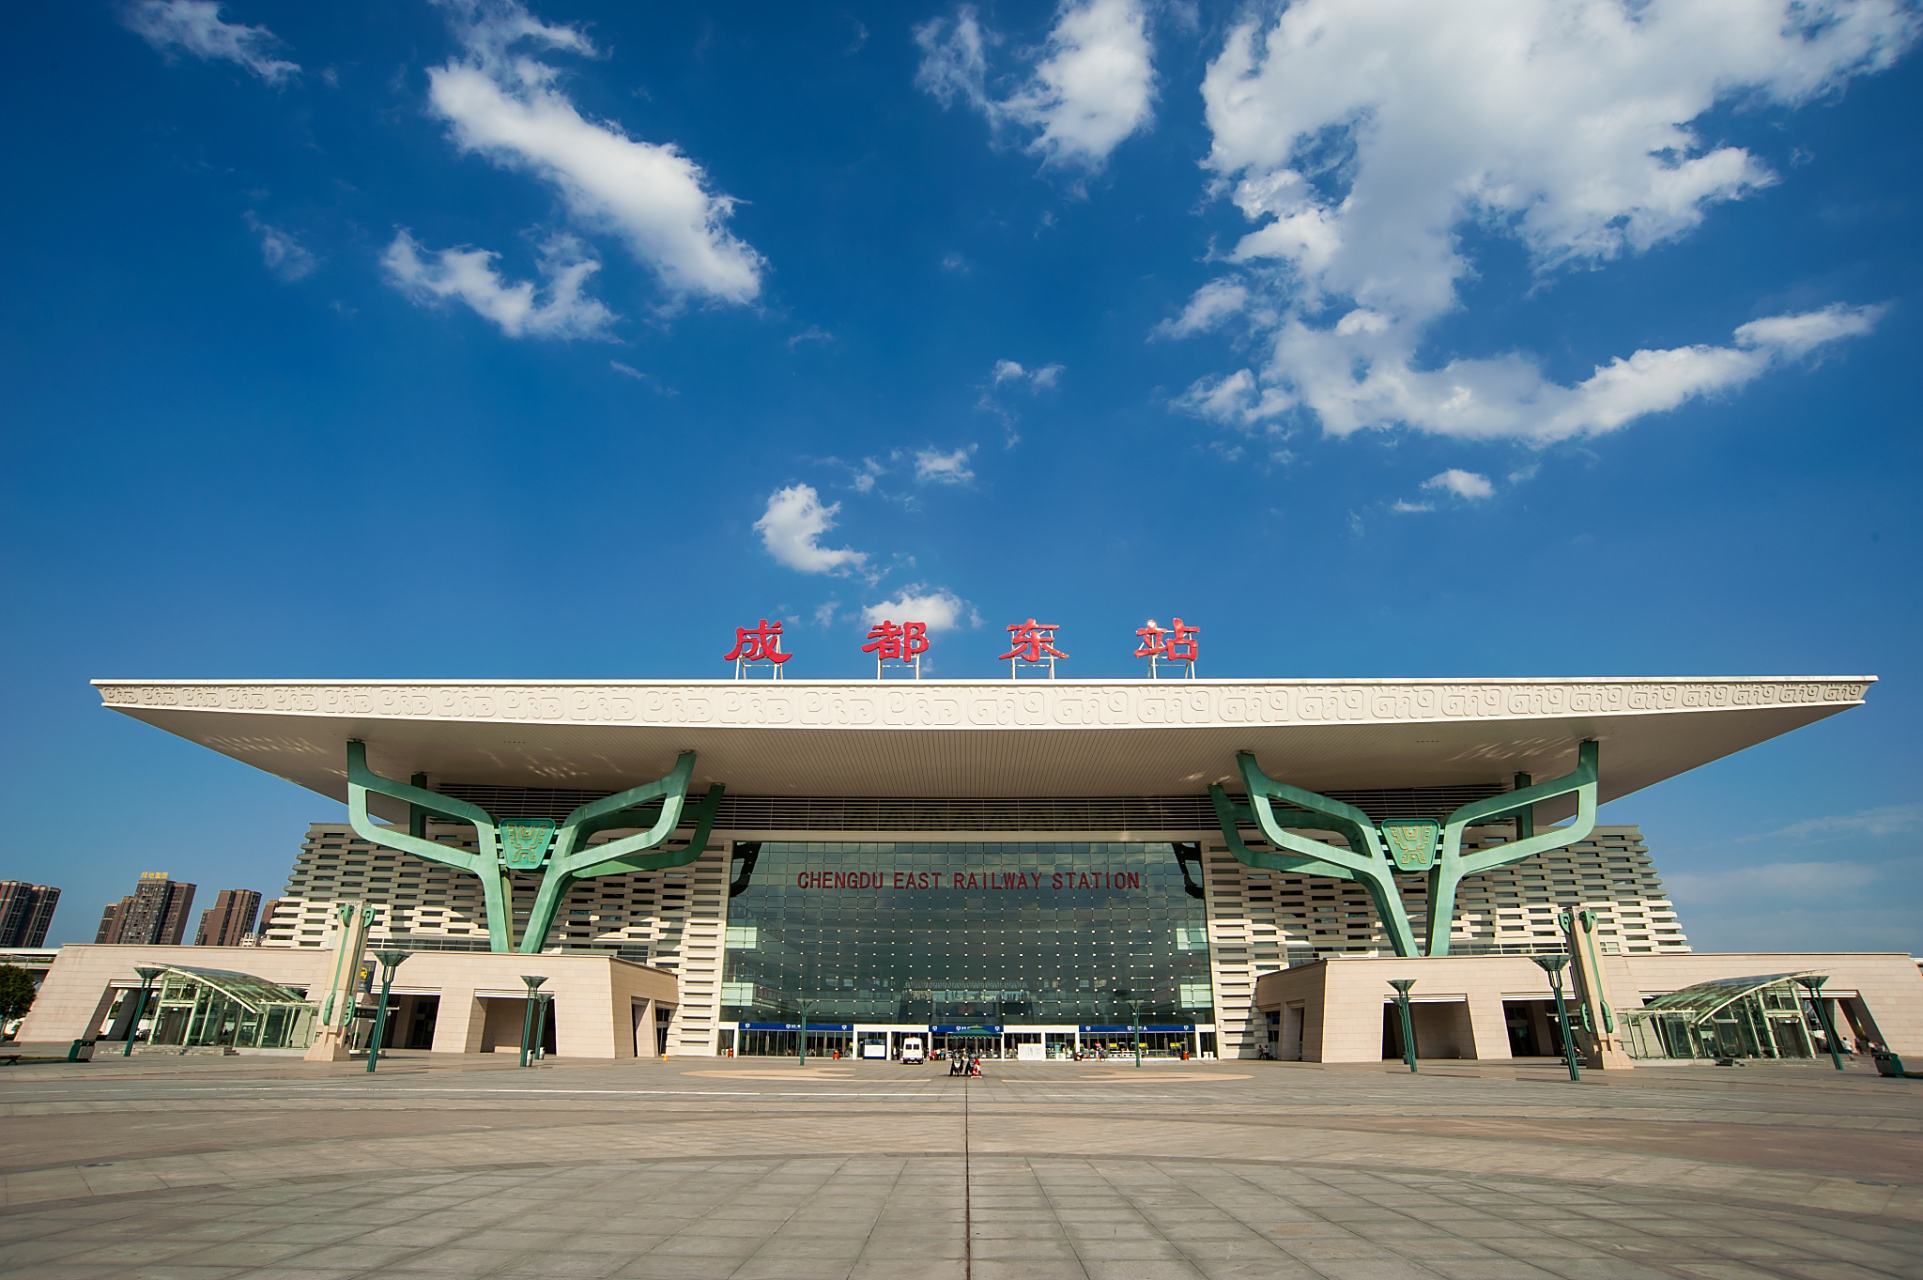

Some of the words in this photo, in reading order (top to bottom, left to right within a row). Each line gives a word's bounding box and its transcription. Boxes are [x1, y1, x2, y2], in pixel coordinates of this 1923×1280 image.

[723, 617, 1201, 664] 成都东站
[797, 871, 884, 889] CHENGDU
[893, 871, 942, 890] EAST
[953, 871, 1042, 890] RAILWAY
[1052, 871, 1140, 890] STATION
